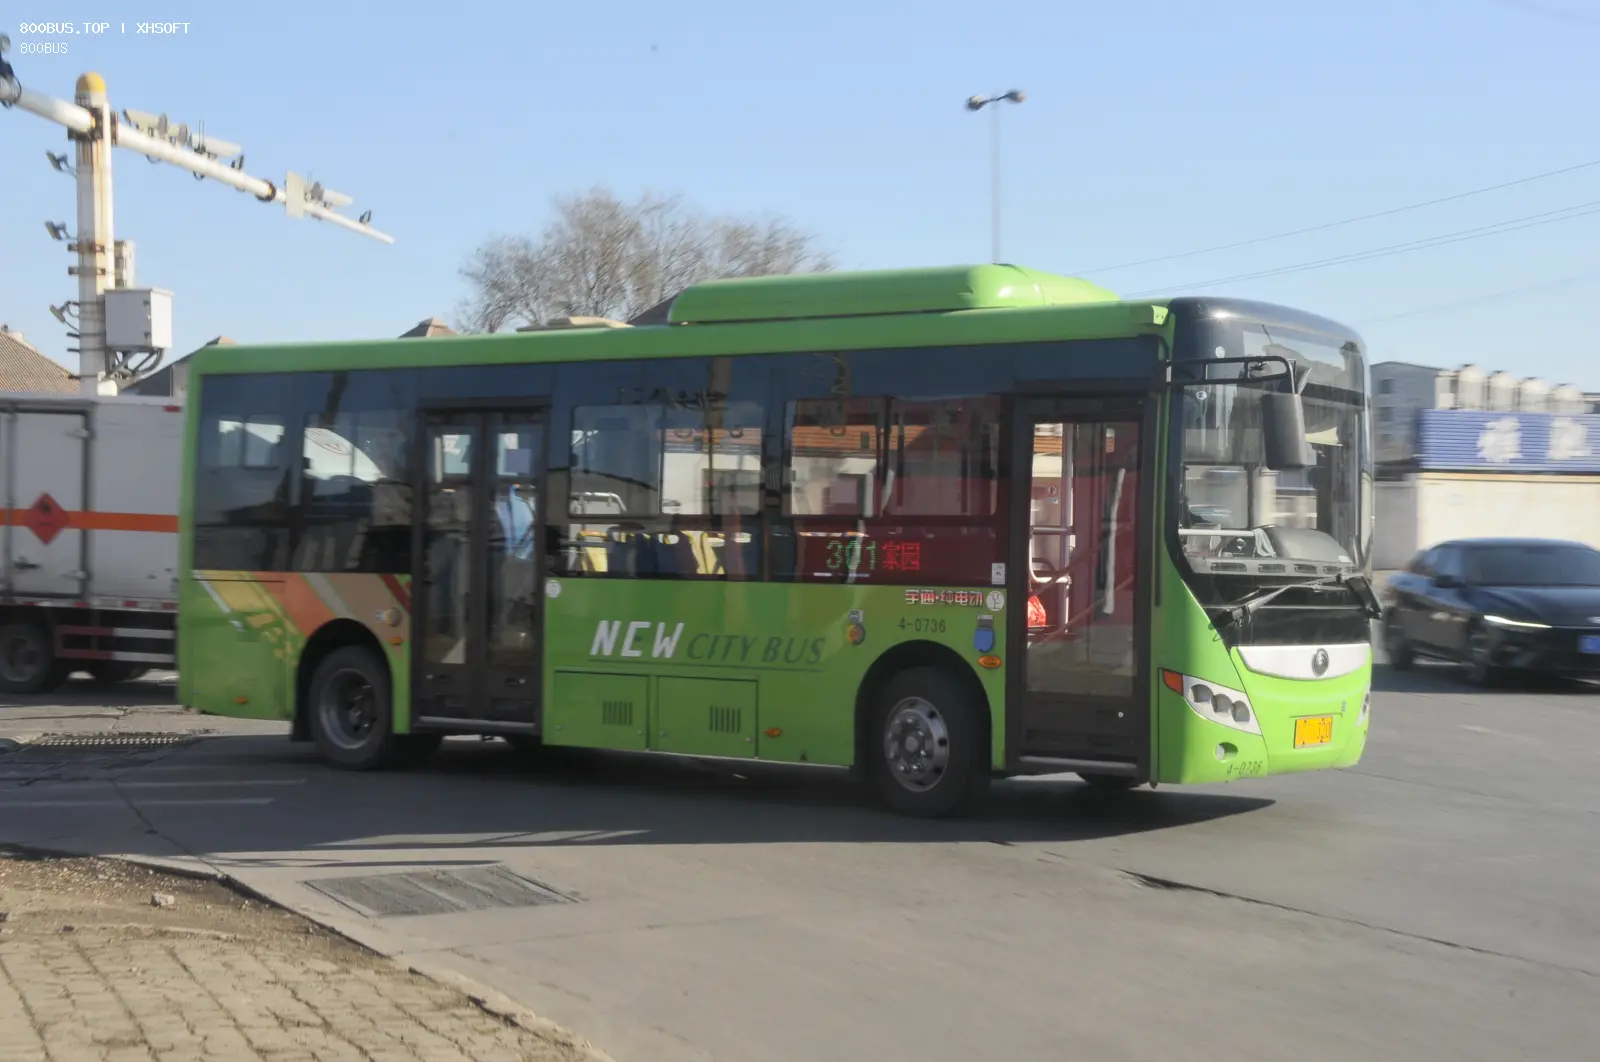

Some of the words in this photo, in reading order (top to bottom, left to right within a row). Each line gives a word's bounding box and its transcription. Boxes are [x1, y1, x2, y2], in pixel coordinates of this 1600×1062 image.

[826, 540, 876, 570] 301
[898, 617, 947, 633] 4-0736
[589, 620, 684, 658] NEW
[687, 633, 756, 662] CITY
[761, 637, 826, 664] BUS
